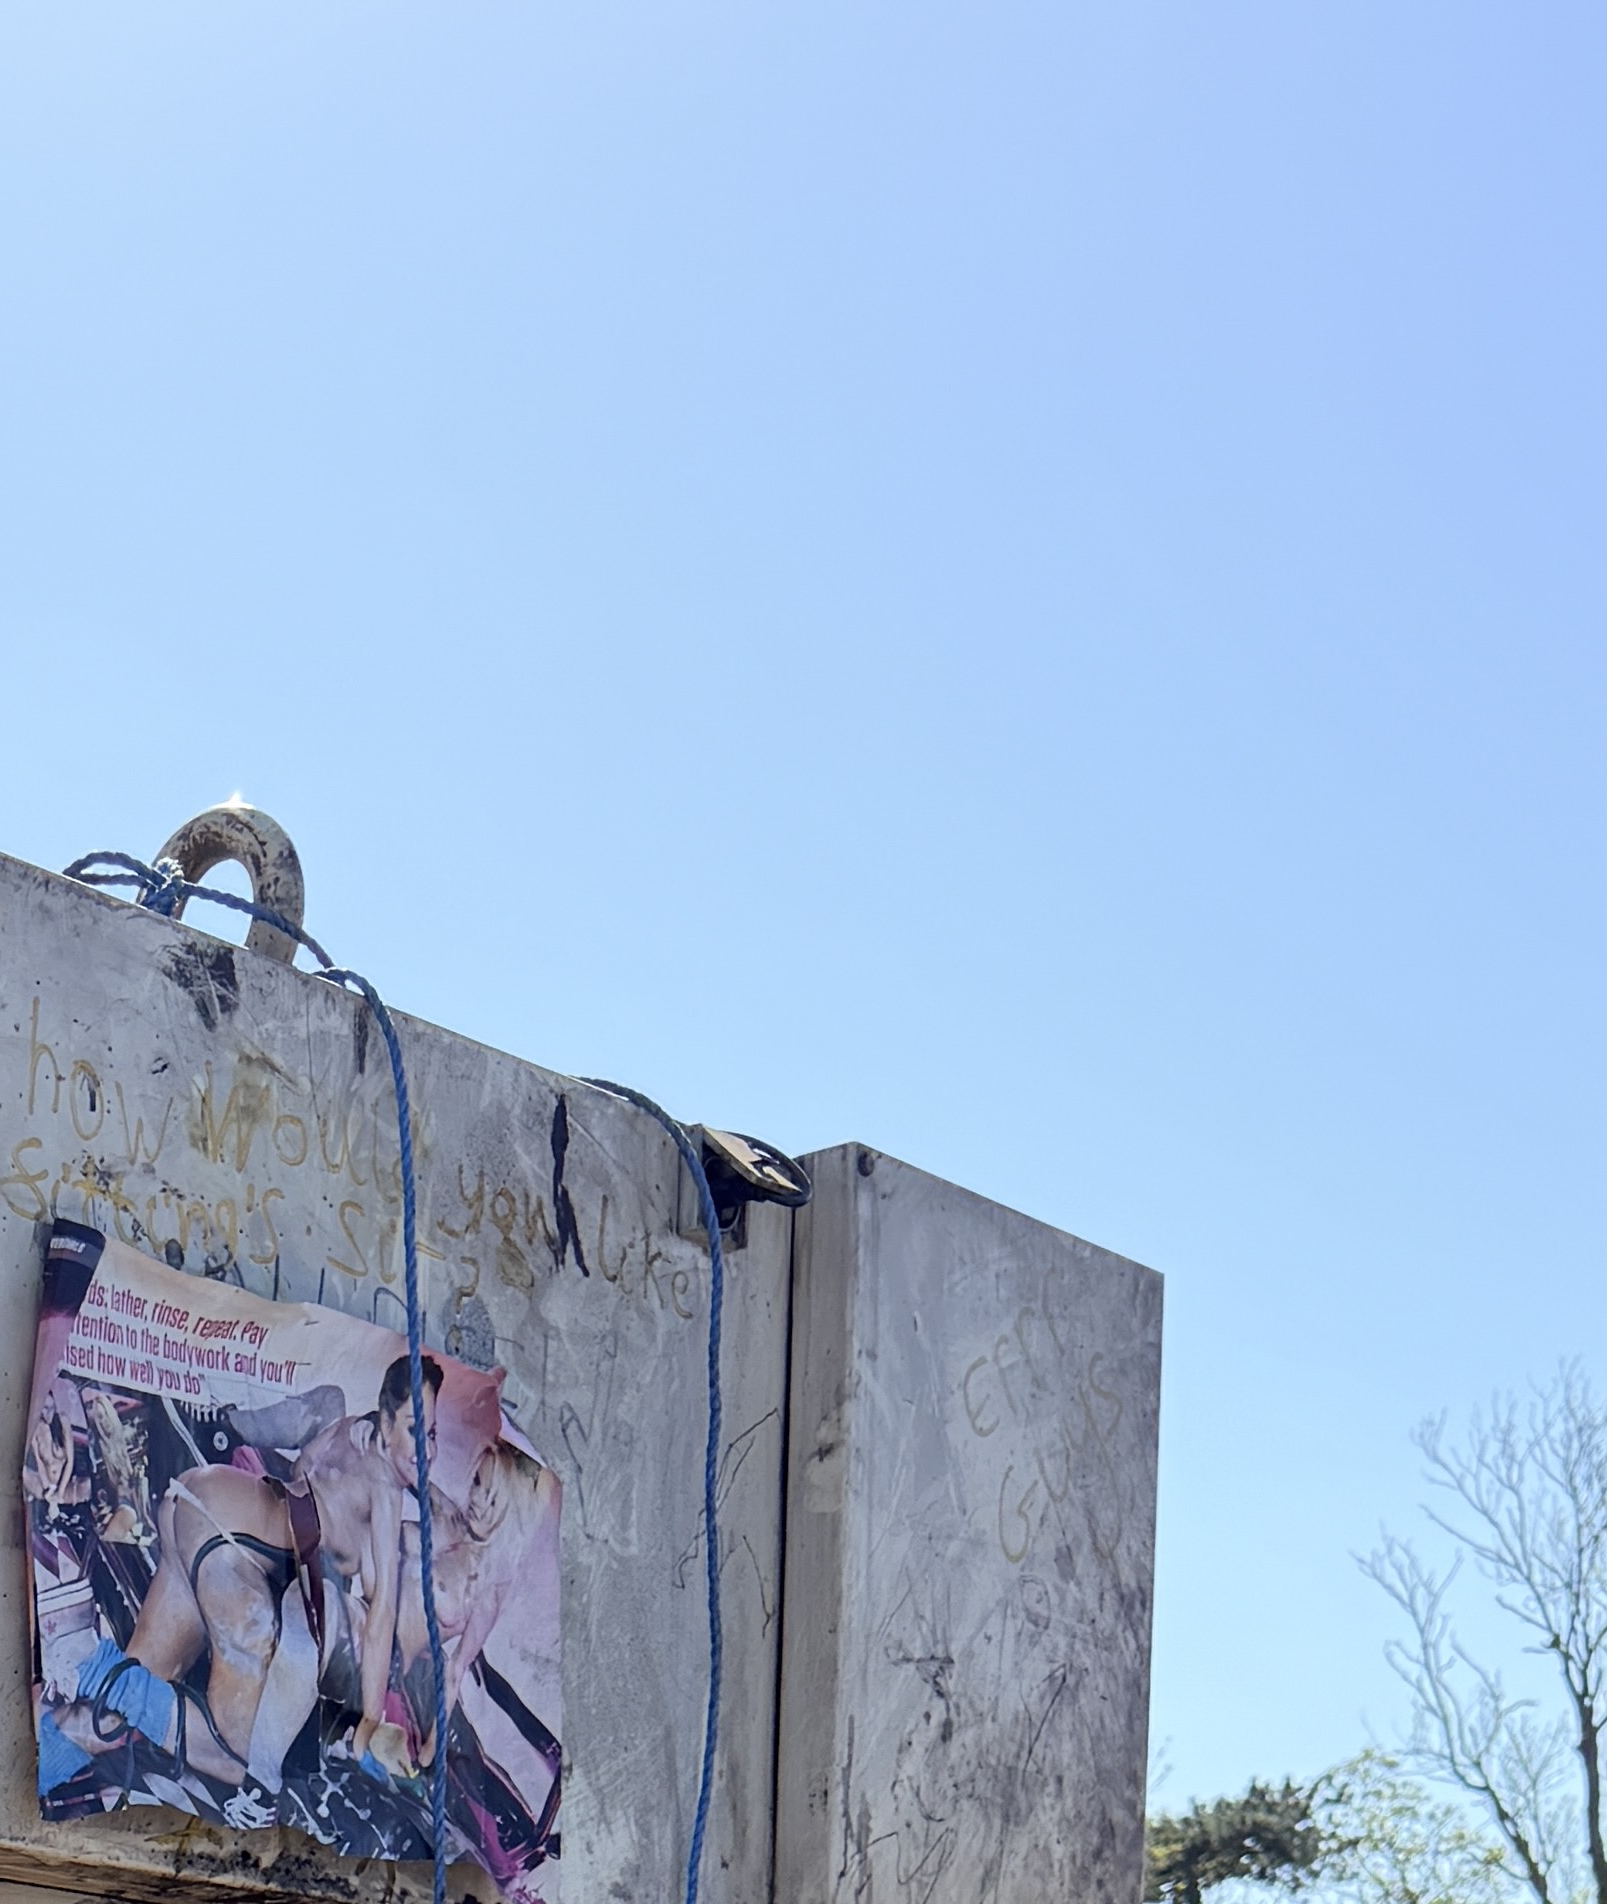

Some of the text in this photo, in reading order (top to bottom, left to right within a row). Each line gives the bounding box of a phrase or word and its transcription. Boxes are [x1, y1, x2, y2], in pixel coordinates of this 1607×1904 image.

[28, 996, 174, 1168] how
[110, 1284, 148, 1323] lather,
[151, 1299, 190, 1334] rinse,
[240, 1320, 270, 1351] Pay
[97, 1347, 127, 1378] how
[129, 1358, 155, 1385] well
[156, 1367, 182, 1391] you
[126, 1325, 138, 1350] to
[139, 1327, 160, 1356] the
[162, 1332, 231, 1372] bodywork
[234, 1350, 258, 1377] and
[259, 1358, 297, 1386] you'll
